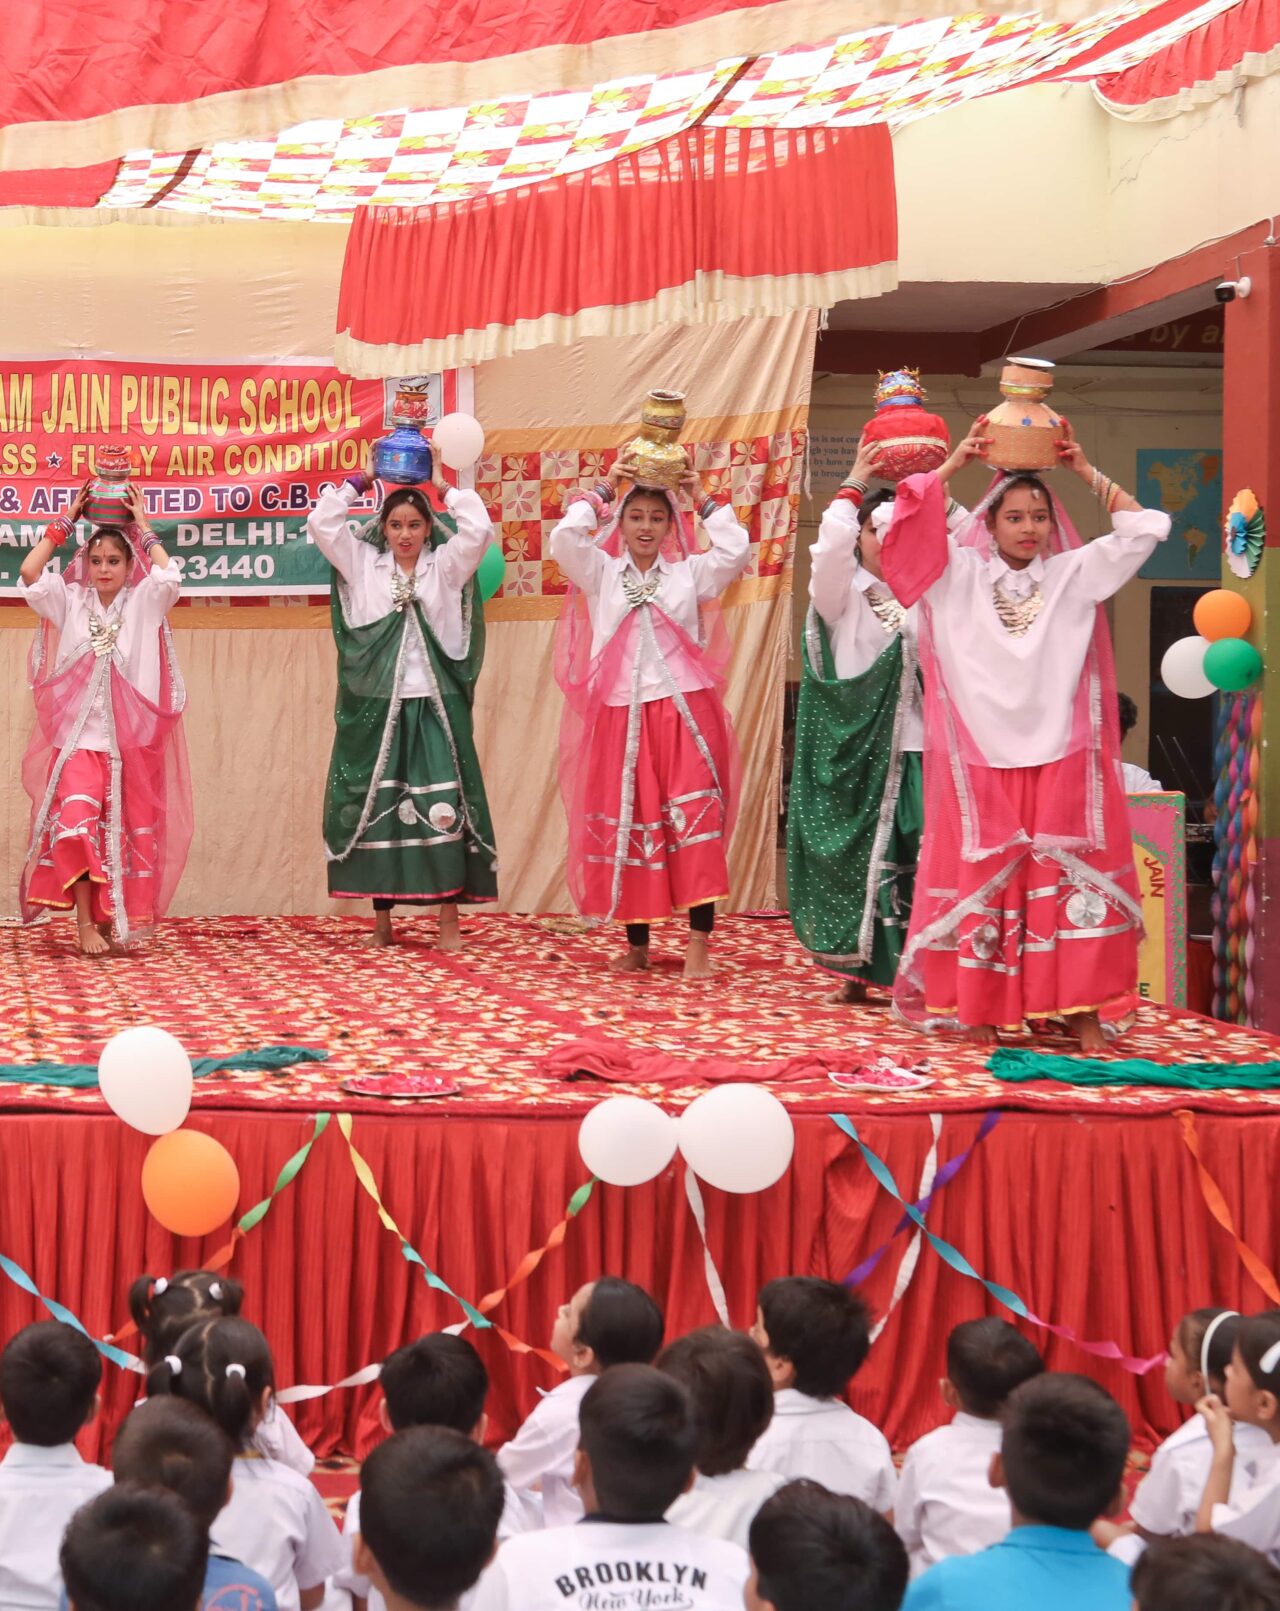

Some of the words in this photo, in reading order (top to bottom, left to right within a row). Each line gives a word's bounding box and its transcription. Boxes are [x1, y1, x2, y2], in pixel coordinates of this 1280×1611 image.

[1150, 324, 1190, 348] by
[1201, 324, 1224, 344] a
[41, 373, 110, 434] JAIN
[121, 374, 230, 436] PUBLIC
[238, 377, 361, 436] SCHOOL
[166, 445, 215, 476] AIR
[0, 486, 21, 513] &
[211, 486, 253, 512] TO
[1144, 857, 1165, 898] JAIN
[555, 1561, 708, 1598] BROOKLYN
